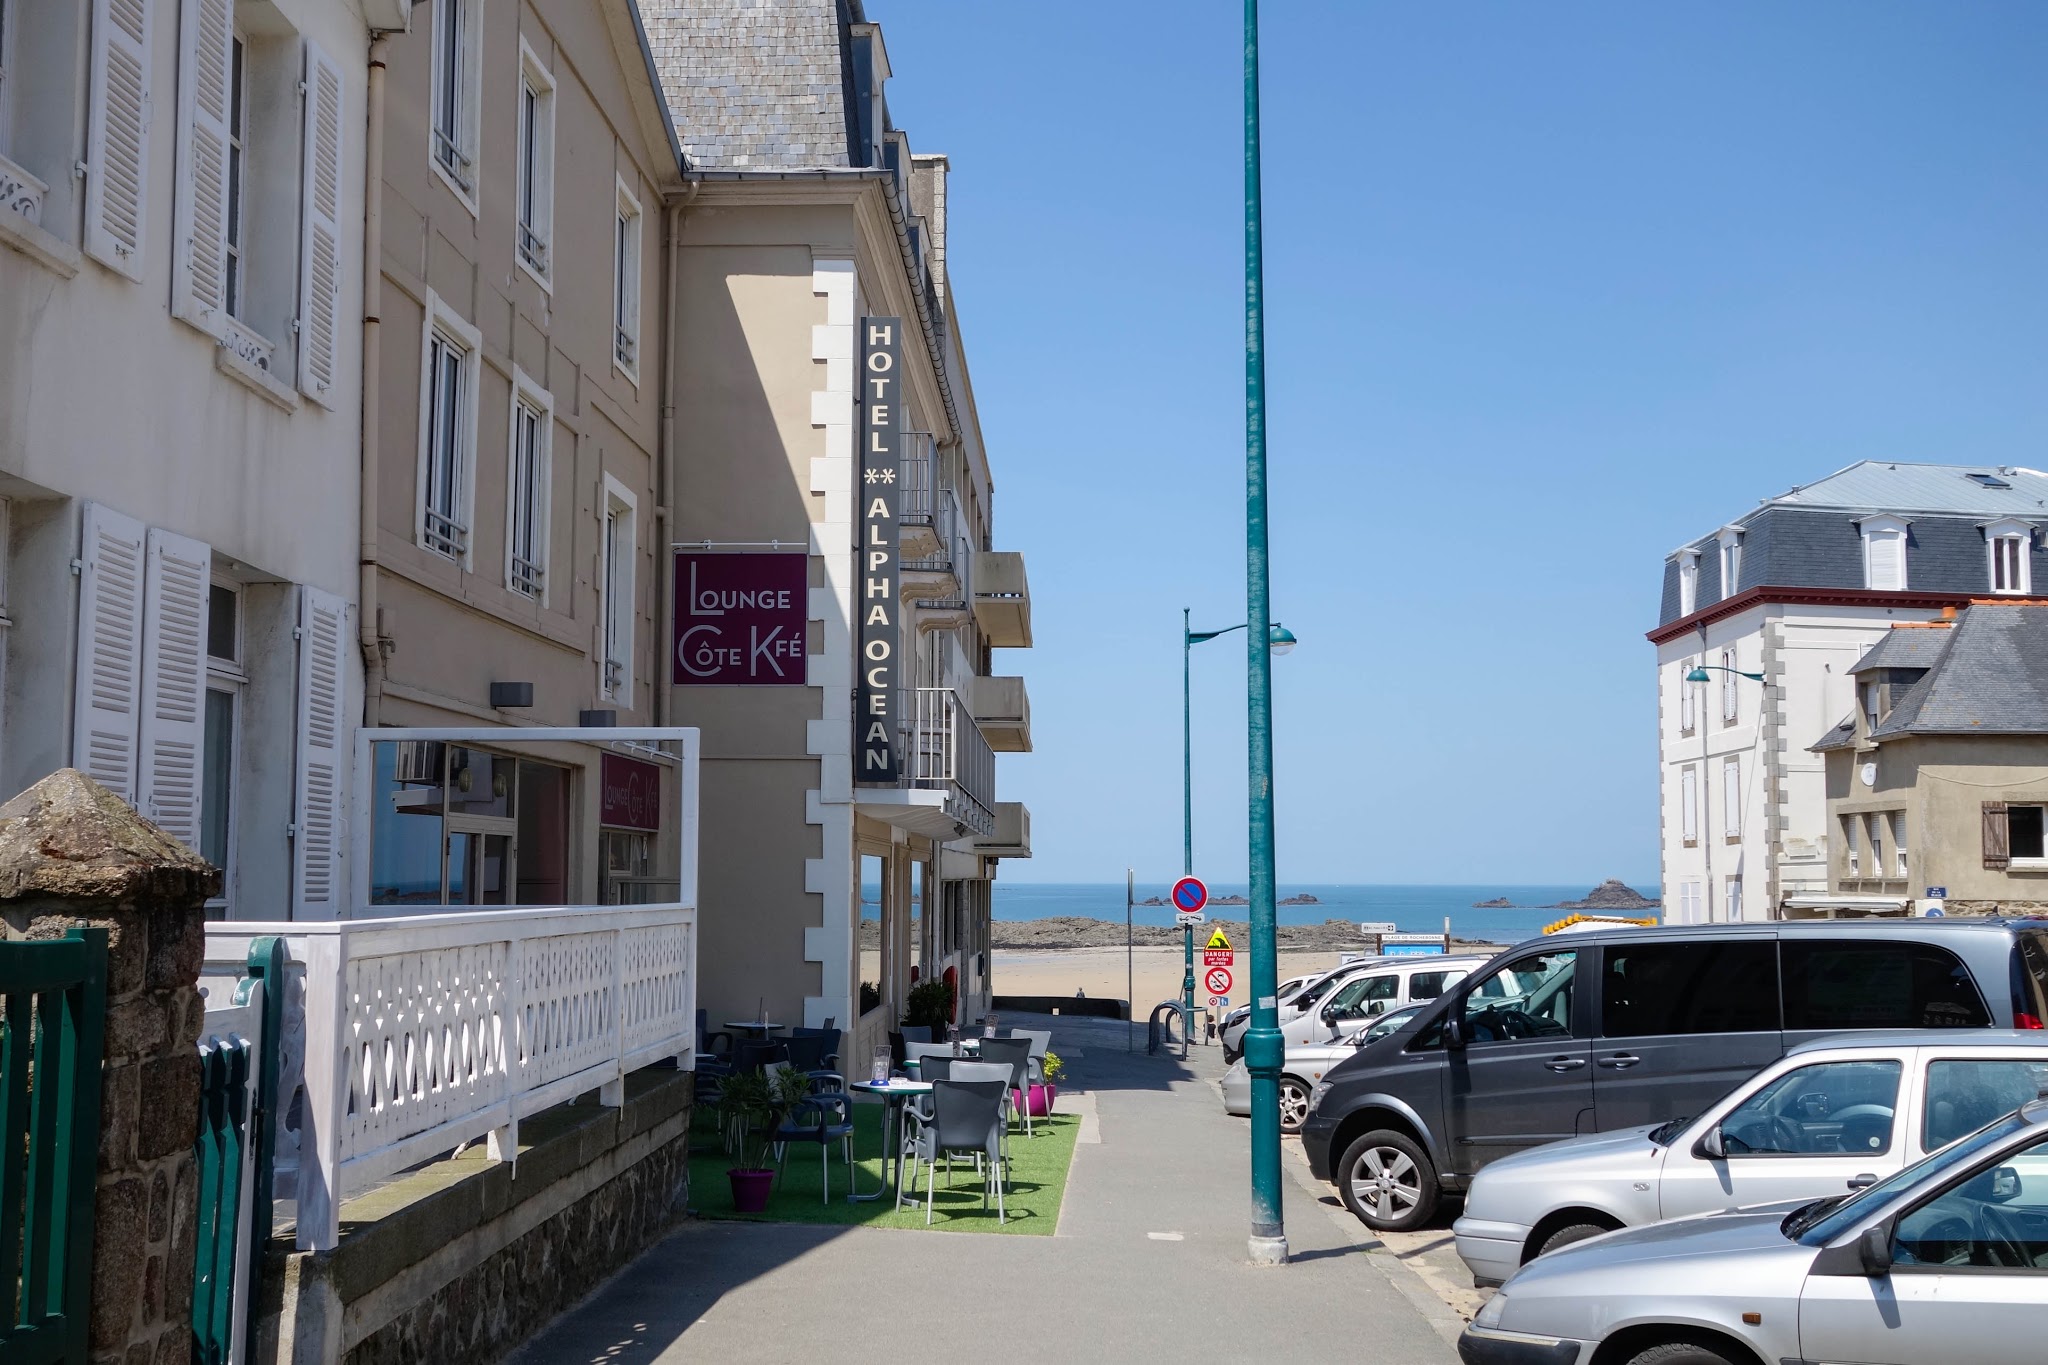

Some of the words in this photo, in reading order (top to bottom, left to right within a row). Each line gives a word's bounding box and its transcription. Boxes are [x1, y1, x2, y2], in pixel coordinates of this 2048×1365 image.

[867, 325, 893, 452] HOTEL
[690, 561, 791, 616] LOUNGE
[866, 498, 890, 626] ALPHA
[678, 624, 742, 677] CÔTE
[750, 625, 802, 677] KFÉ
[865, 639, 891, 770] OCEAN
